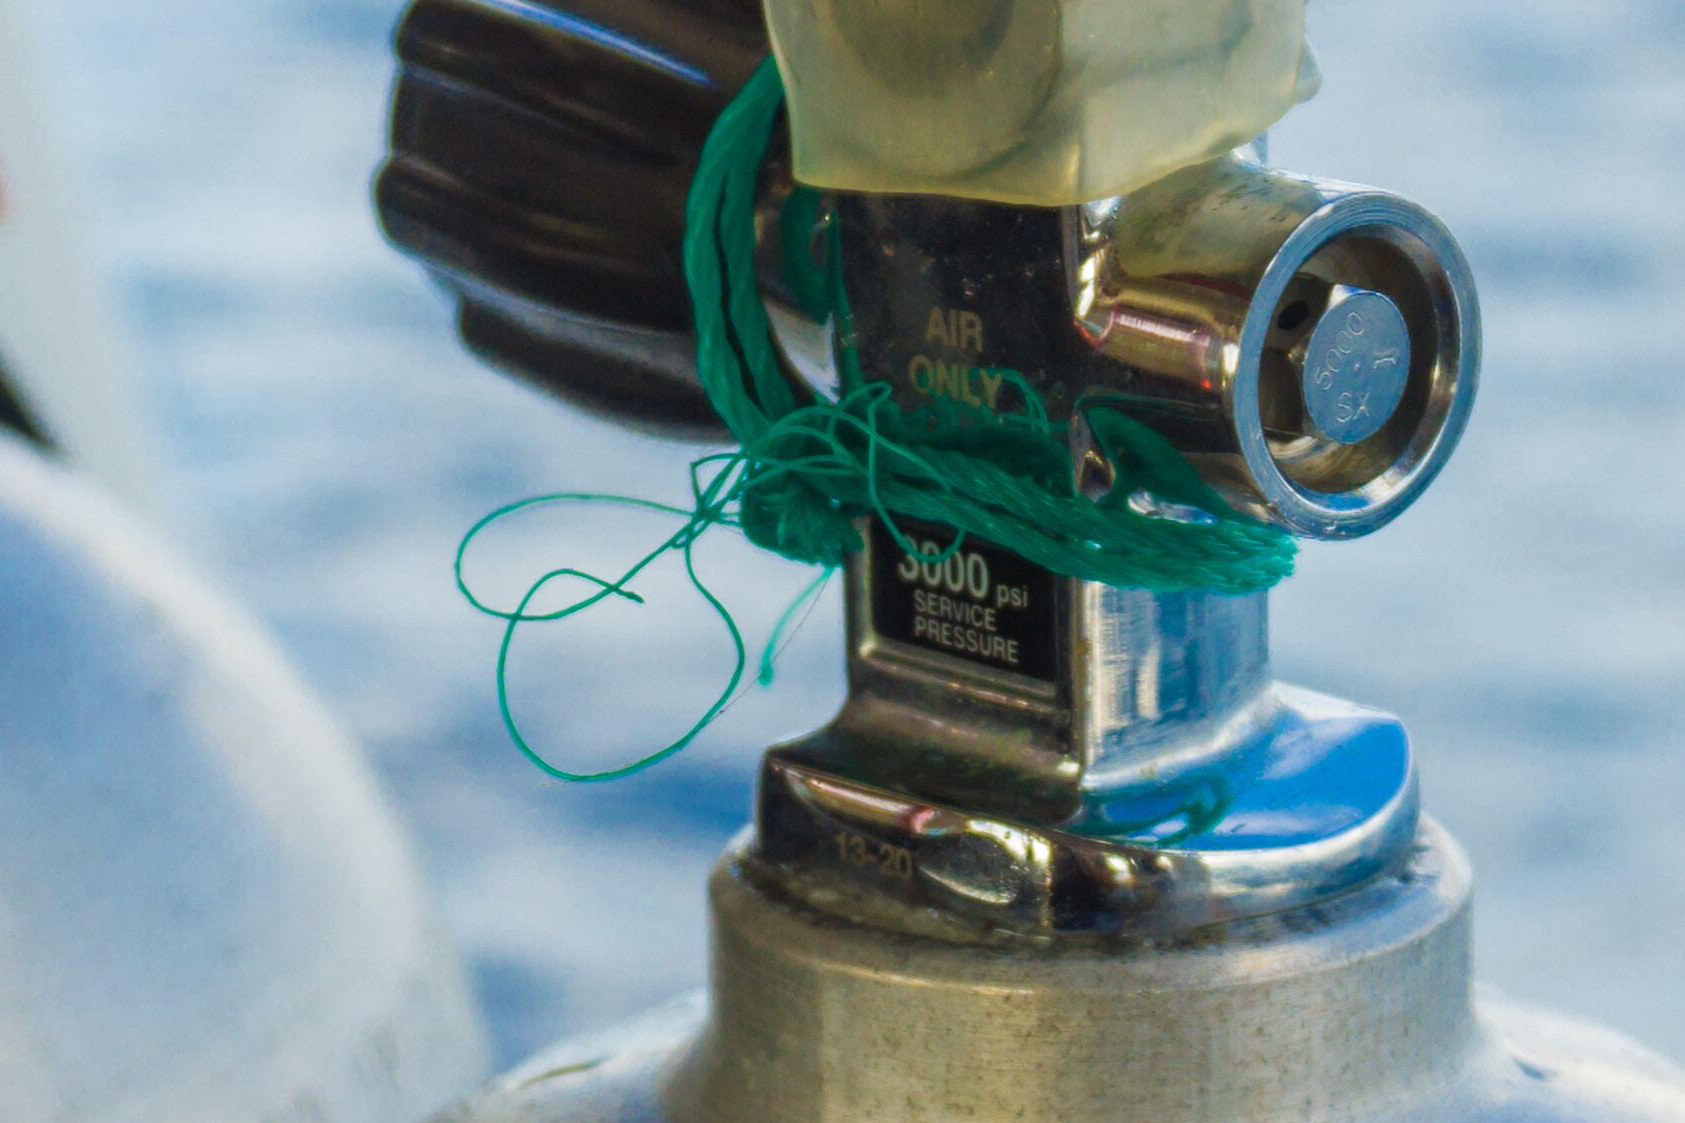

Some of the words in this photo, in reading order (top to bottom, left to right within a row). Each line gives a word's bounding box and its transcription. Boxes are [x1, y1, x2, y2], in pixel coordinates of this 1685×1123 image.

[925, 305, 983, 352] AIR
[909, 354, 1003, 410] ONLY
[897, 533, 990, 599] 3000
[997, 584, 1029, 608] psi
[915, 589, 997, 631] SERVICE
[915, 616, 1019, 664] PRESSURE
